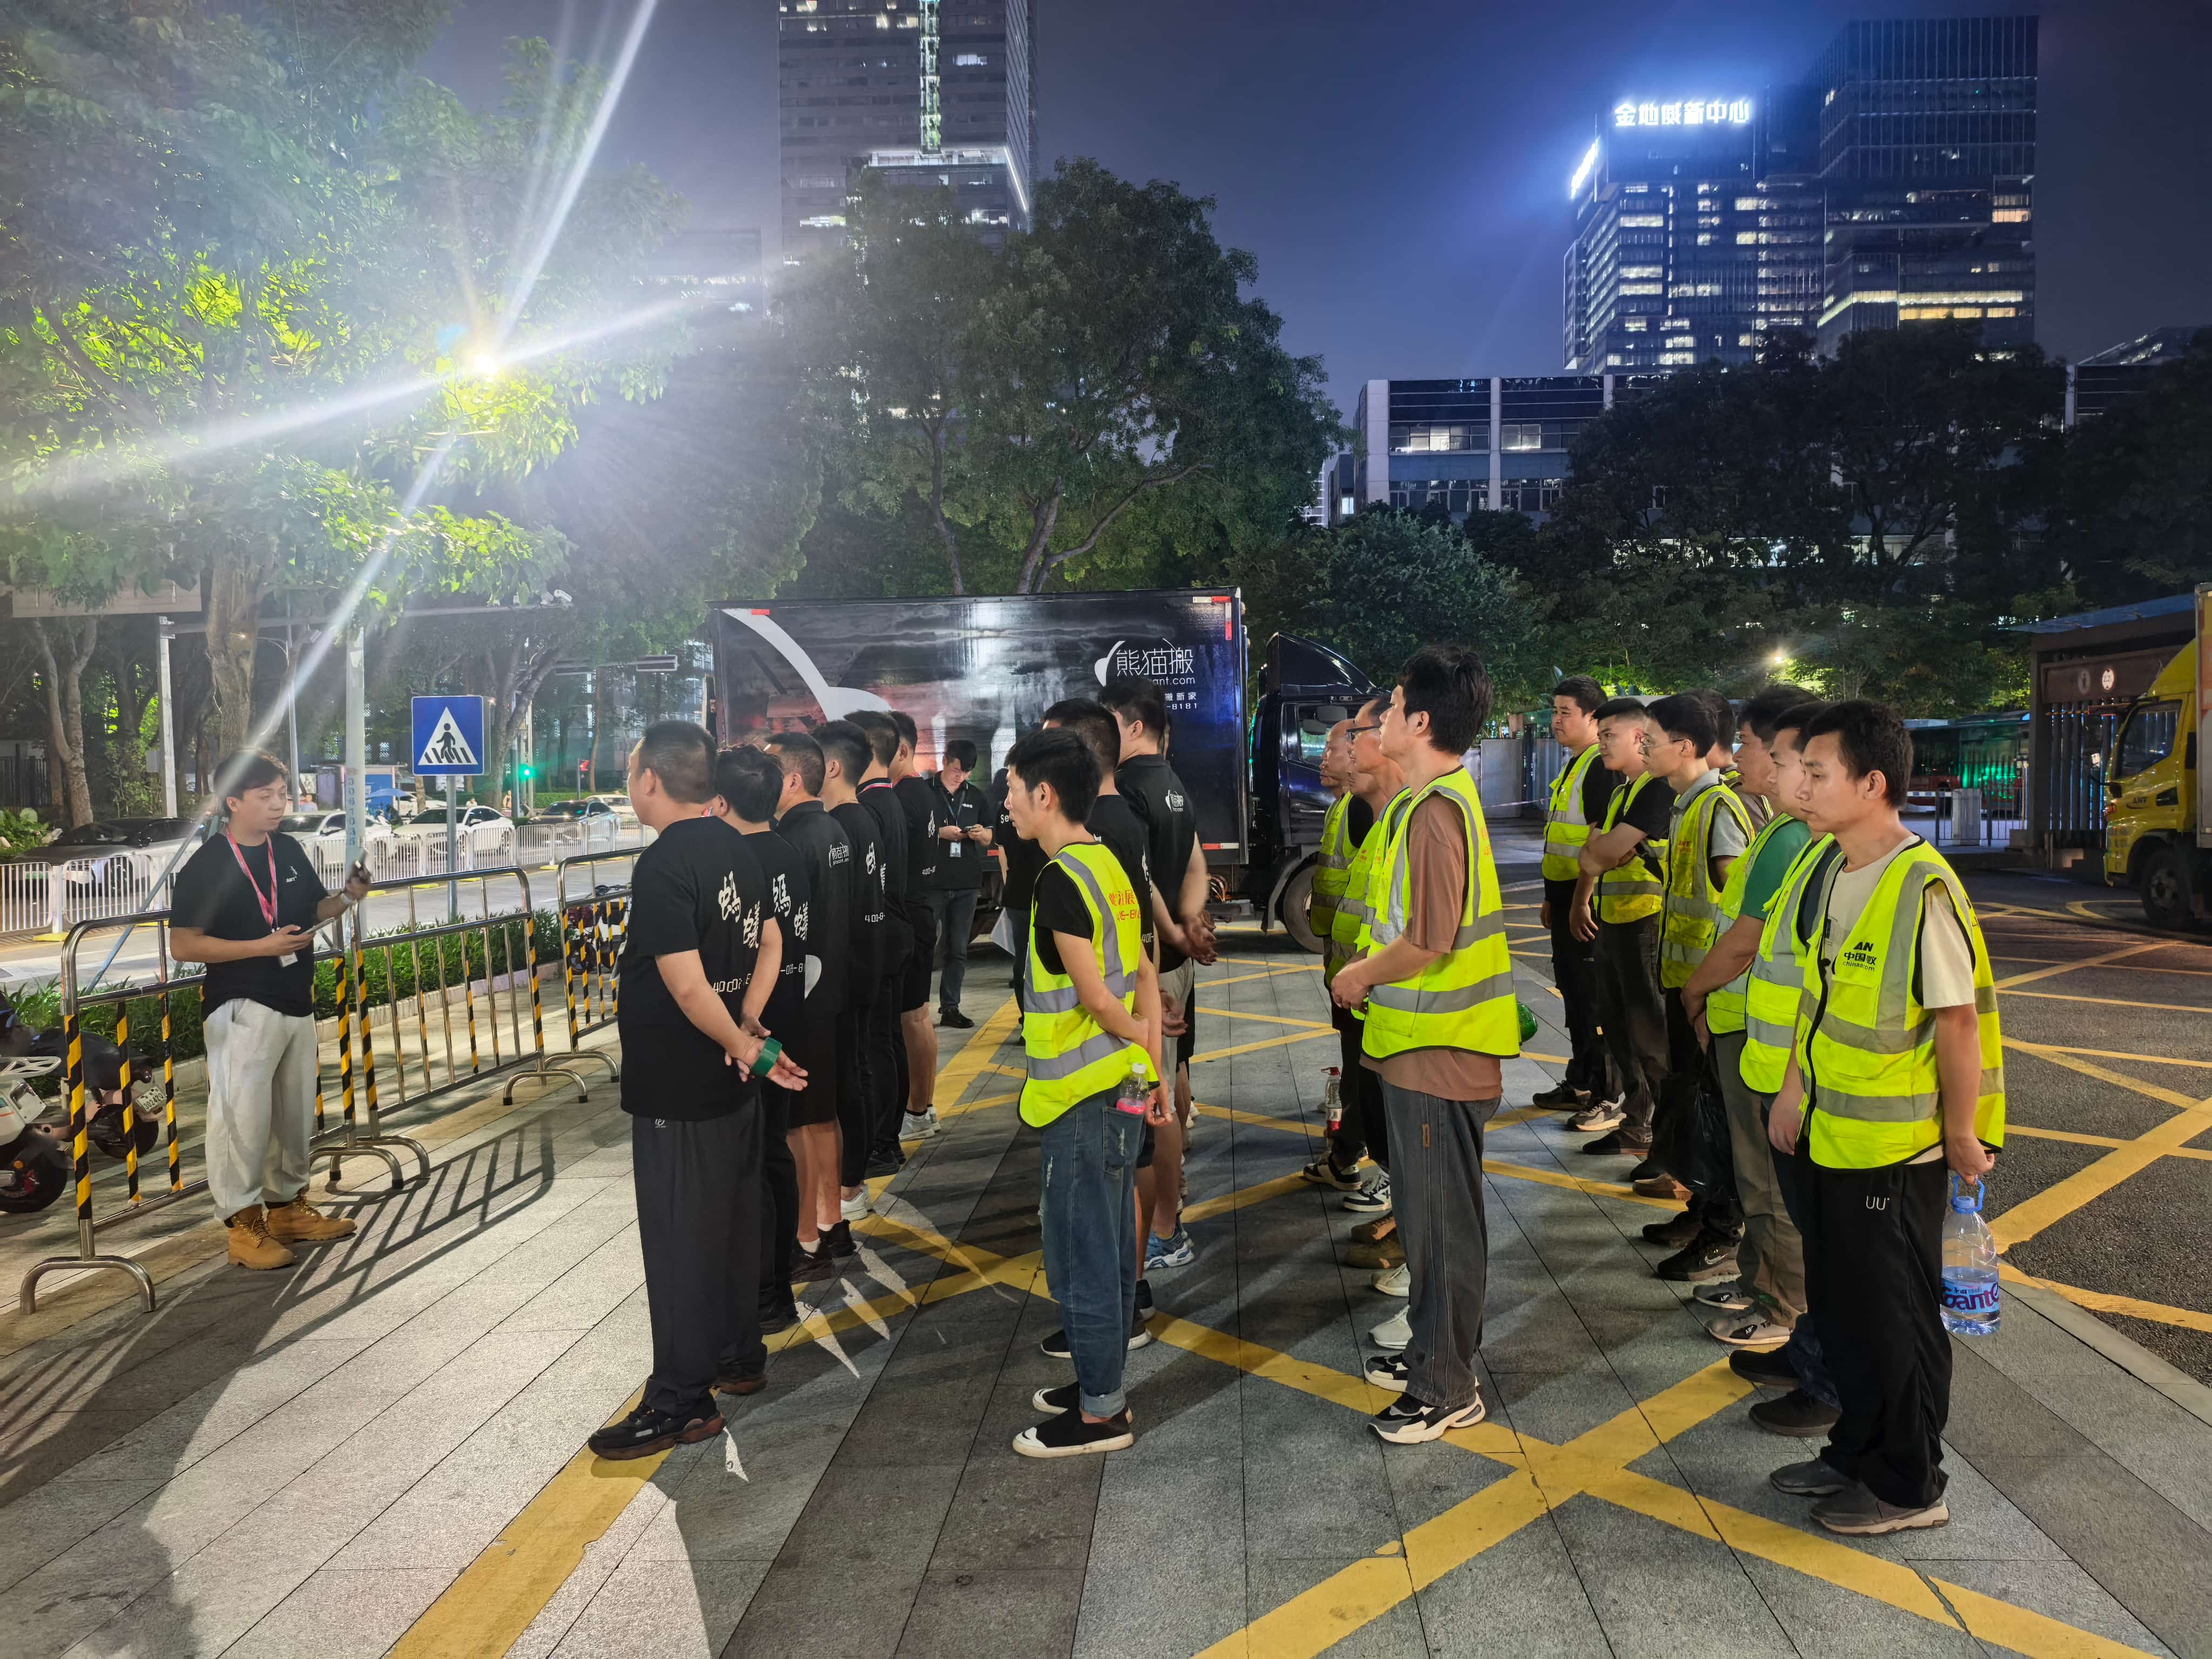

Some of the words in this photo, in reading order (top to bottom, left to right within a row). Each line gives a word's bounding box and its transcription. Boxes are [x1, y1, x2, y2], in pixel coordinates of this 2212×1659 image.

[1614, 101, 1749, 126] 金地威新中心
[1116, 648, 1193, 676] 熊猫搬
